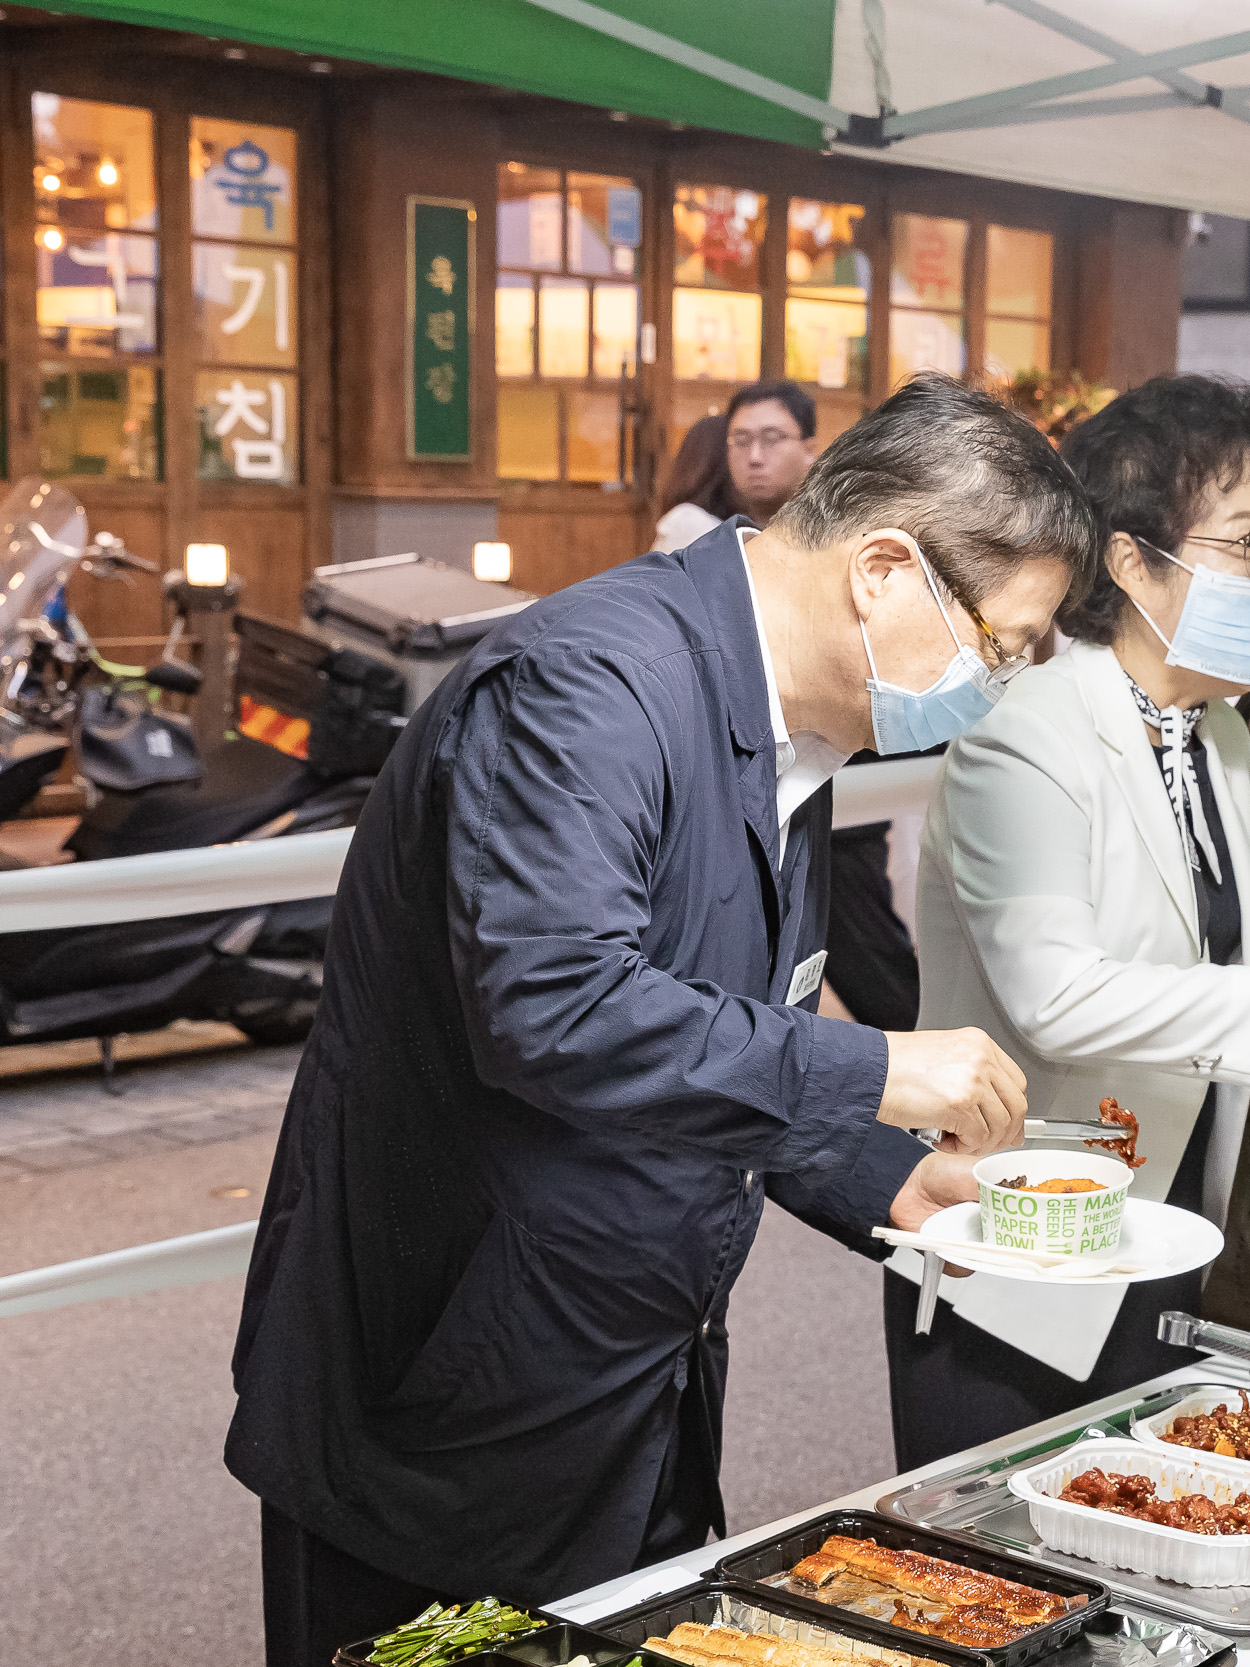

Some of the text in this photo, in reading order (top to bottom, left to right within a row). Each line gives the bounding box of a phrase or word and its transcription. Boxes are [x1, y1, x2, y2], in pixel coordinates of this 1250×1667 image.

[991, 1189, 1038, 1218] ECO
[1084, 1187, 1126, 1212] MAKE
[993, 1213, 1039, 1237] PAPER
[1046, 1198, 1061, 1238] GREEN
[1062, 1198, 1077, 1238] HELLO
[1083, 1212, 1101, 1224] THE
[1080, 1229, 1119, 1254] PLACE
[1082, 1227, 1089, 1237] A
